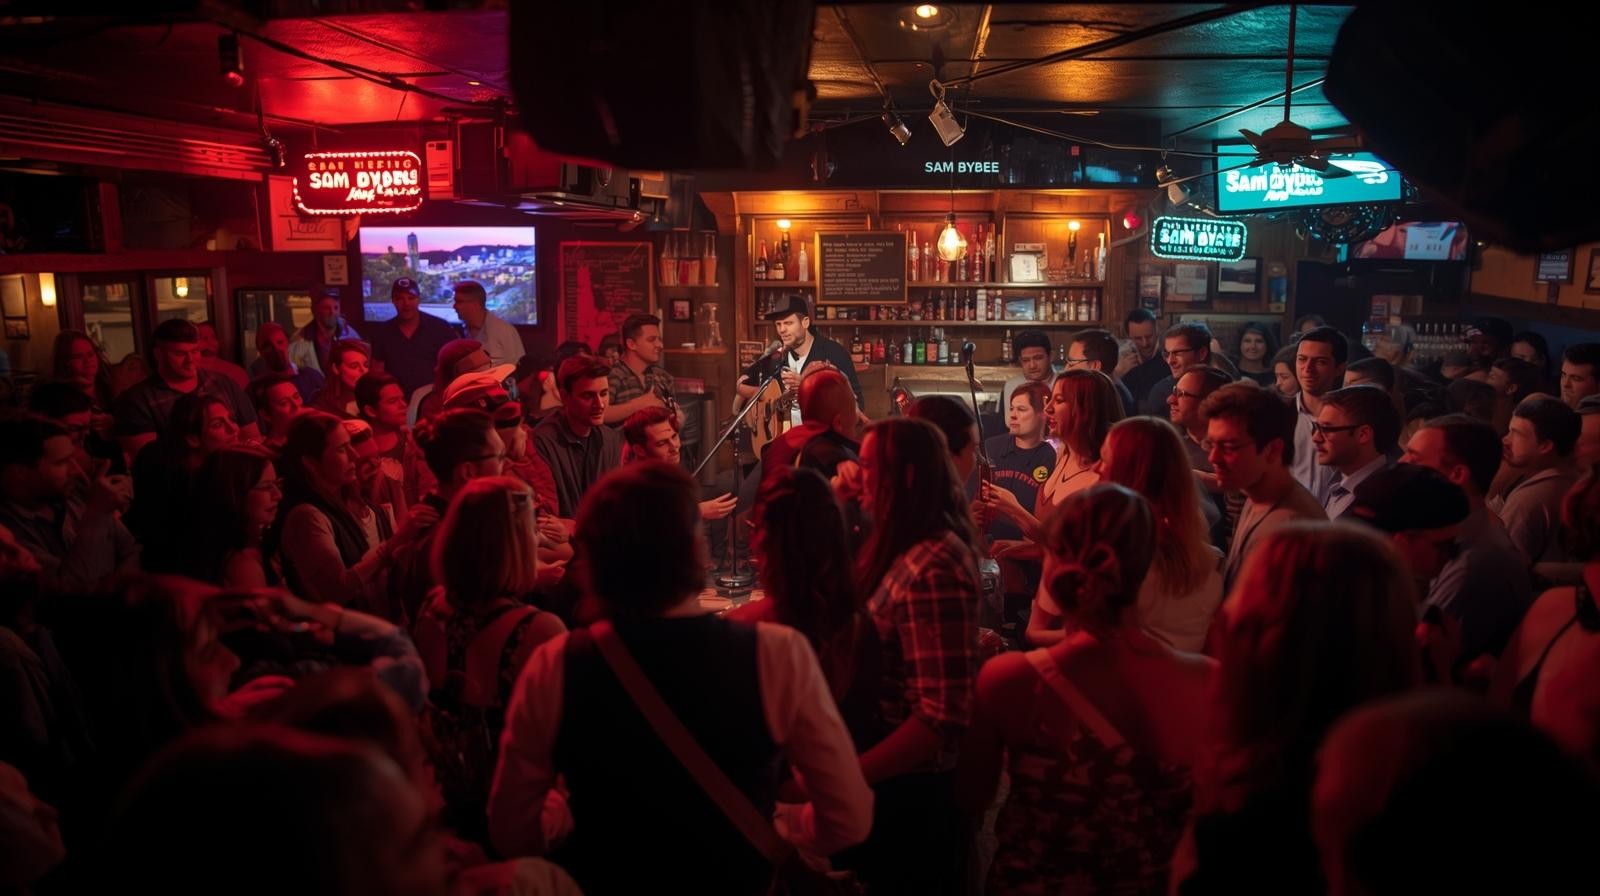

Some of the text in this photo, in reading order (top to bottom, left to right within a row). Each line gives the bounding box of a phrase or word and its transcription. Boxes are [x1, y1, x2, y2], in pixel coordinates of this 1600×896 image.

[925, 161, 1000, 173] SAM BYBEE
[309, 171, 350, 189] SAM
